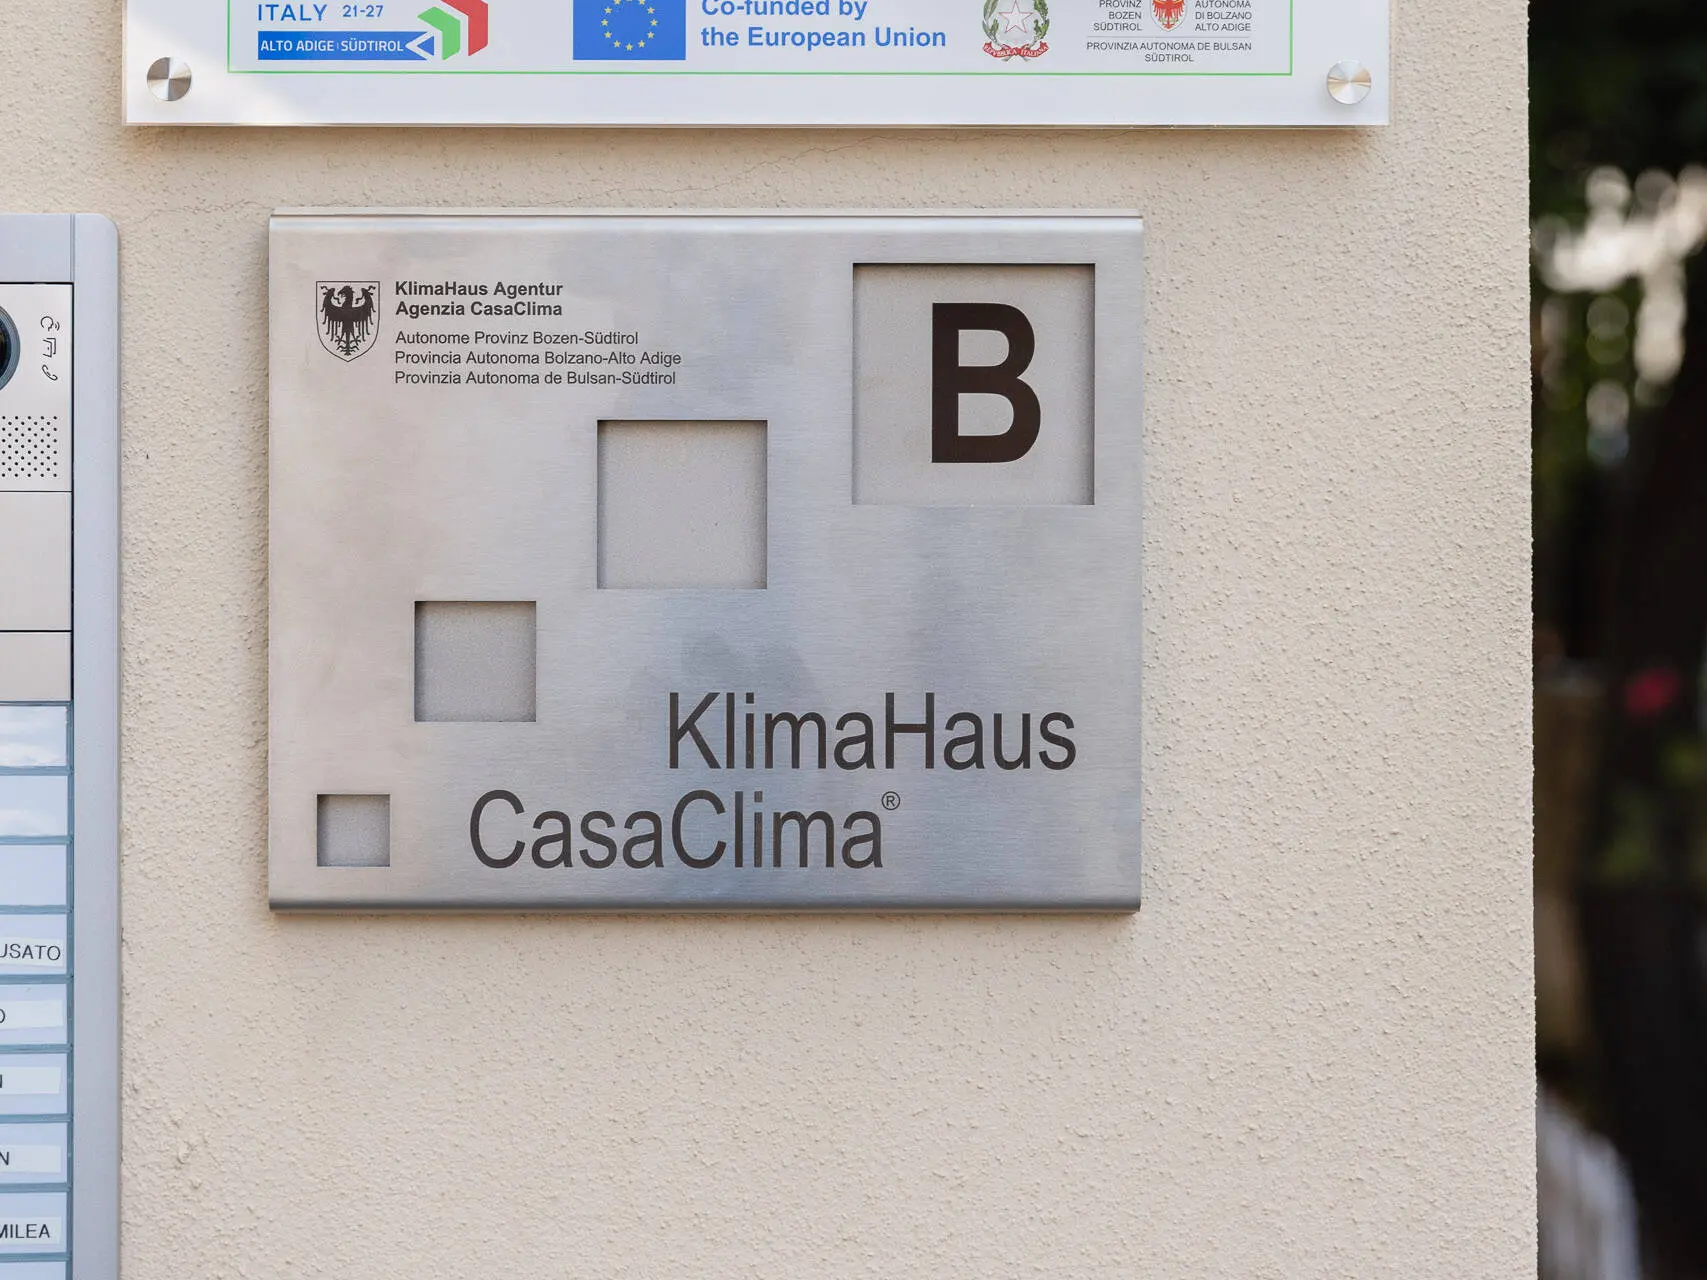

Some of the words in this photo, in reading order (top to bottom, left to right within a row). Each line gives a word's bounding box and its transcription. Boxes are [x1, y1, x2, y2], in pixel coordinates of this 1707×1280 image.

[1099, 0, 1142, 8] PROVINZ
[1195, 0, 1251, 9] AUTONOMA
[258, 4, 327, 21] ITALY
[343, 4, 383, 17] 21-27
[1108, 11, 1142, 20] BOZEN
[1195, 11, 1205, 20] DI
[1207, 11, 1252, 20] BOLZANO
[1093, 21, 1143, 31] SÜDTIROL
[1195, 21, 1220, 32] ALTO
[1220, 22, 1251, 32] ADIGE
[261, 40, 293, 51] ALTO
[296, 40, 334, 51] ADIGE
[341, 38, 403, 51] SÜDTIROL
[701, 26, 739, 46] the
[748, 26, 865, 51] European
[875, 27, 946, 47] Union
[1087, 42, 1139, 50] PROVINZIA
[1140, 42, 1195, 51] AUTONOMA
[1197, 42, 1210, 50] DE
[1213, 42, 1251, 51] BULSAN
[1144, 53, 1194, 62] SÜDTIROL
[396, 281, 488, 296] KlimaHaus
[493, 282, 563, 299] Agentur
[396, 301, 465, 319] Agenzia
[471, 301, 562, 316] CasaClima
[395, 331, 470, 344] Autonome
[475, 331, 528, 344] Provinz
[533, 331, 638, 344] Bozen-Südtirol
[395, 351, 461, 364] Provincia
[466, 351, 539, 364] Autonoma
[545, 351, 636, 364] Bolzano-Alto
[640, 351, 681, 368] Adige
[395, 371, 461, 384] Provinzia
[465, 371, 539, 384] Autonoma
[544, 371, 562, 384] de
[567, 371, 675, 384] Bulsan-Südtirol
[932, 303, 1041, 463] B
[670, 692, 1076, 770] KlimaHaus
